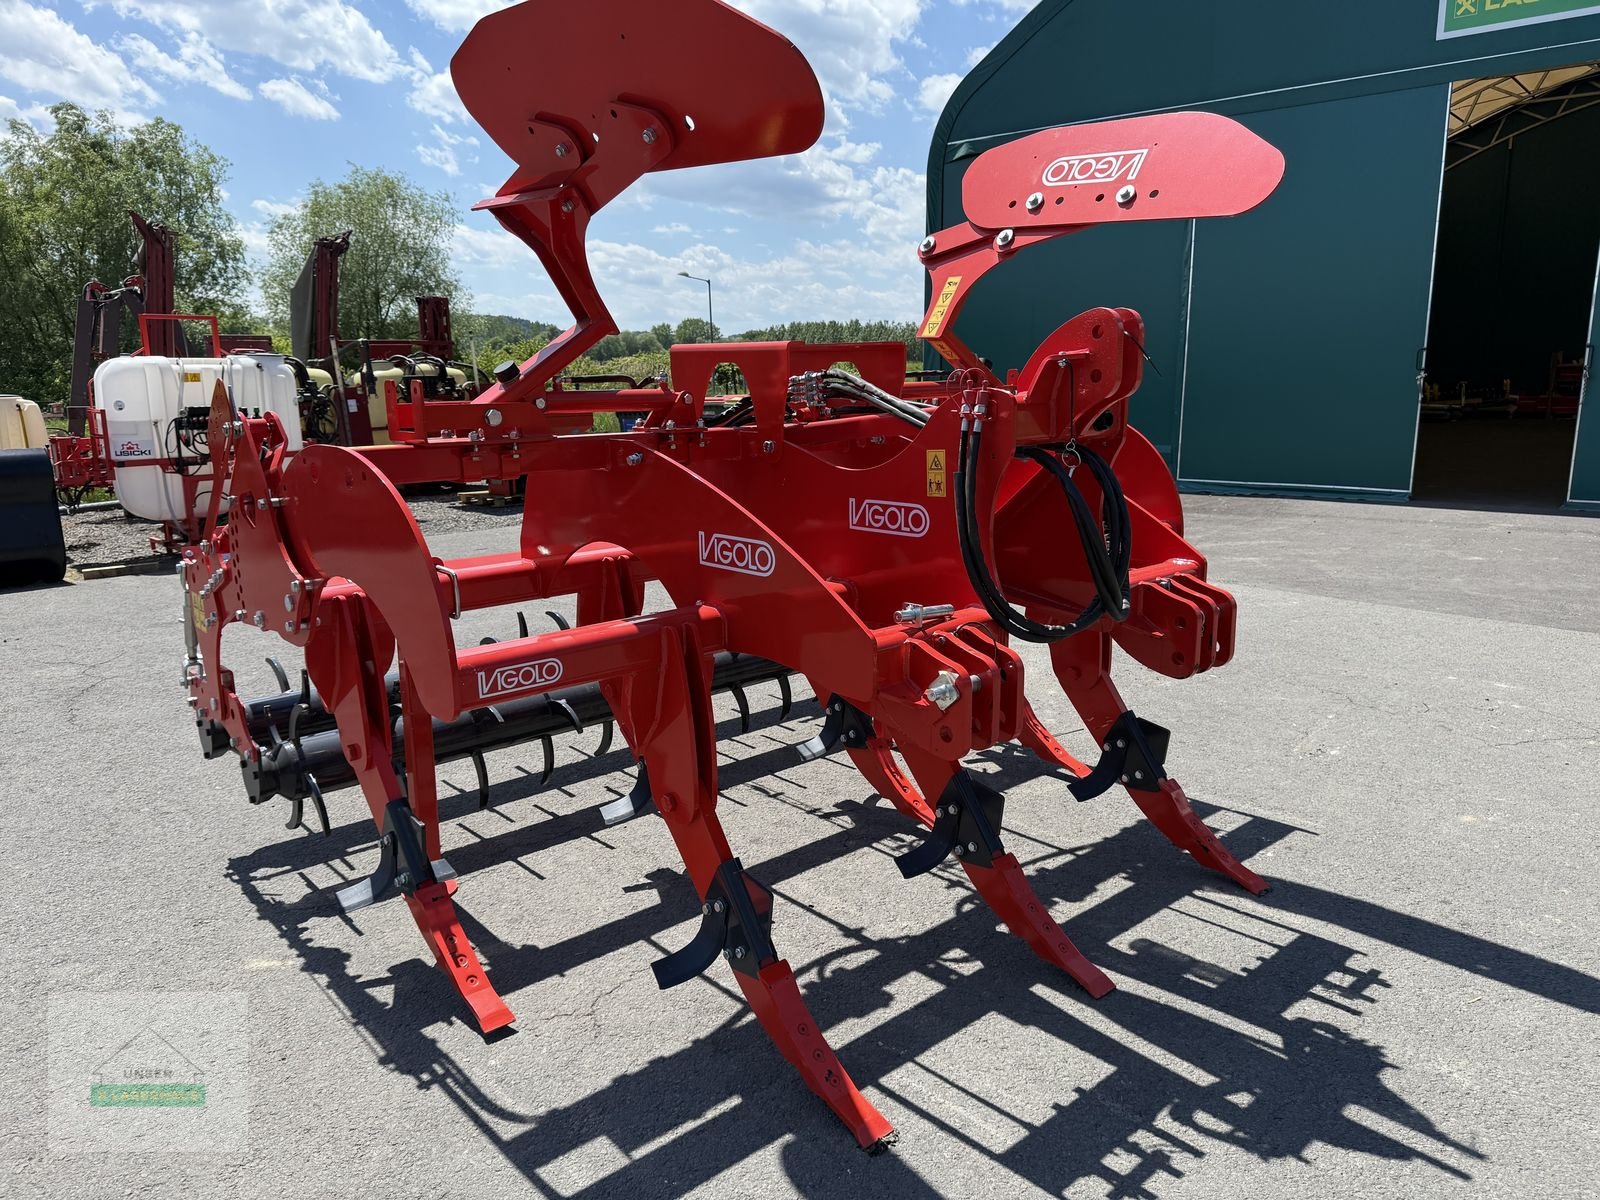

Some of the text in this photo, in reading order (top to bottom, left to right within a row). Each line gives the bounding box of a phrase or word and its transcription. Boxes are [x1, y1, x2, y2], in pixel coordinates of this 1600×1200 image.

[1042, 149, 1148, 186] VIGOLO
[849, 498, 930, 538] VIGOLO
[699, 531, 776, 577] VIGOLO
[478, 658, 563, 698] VIGOLO
